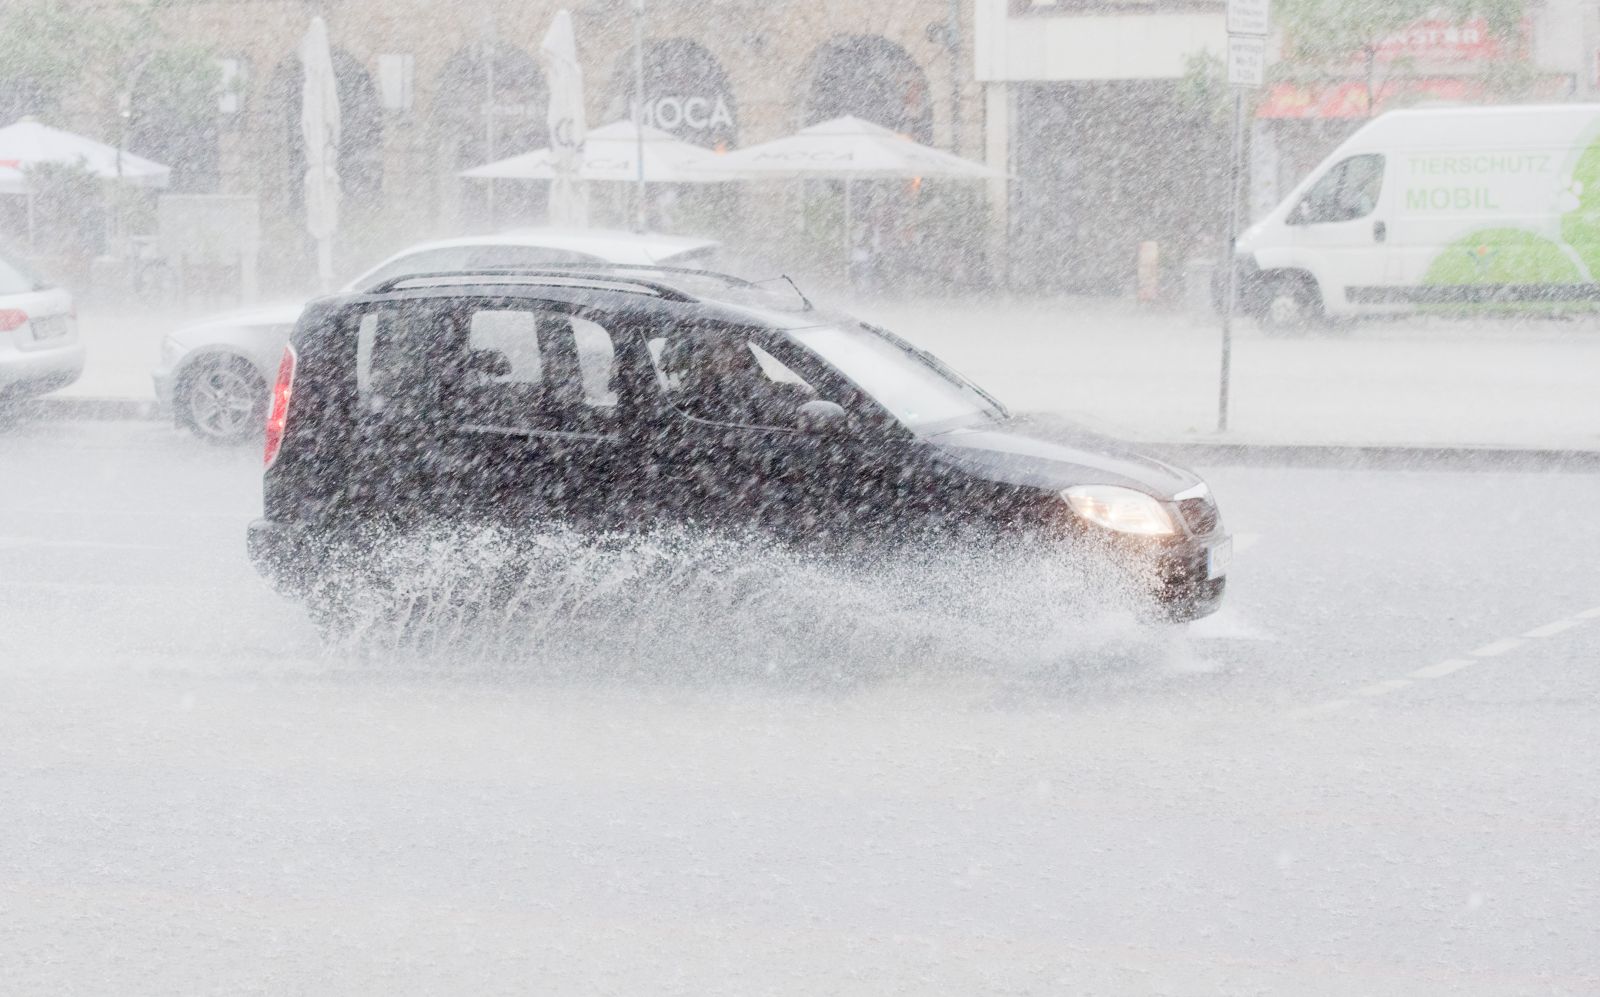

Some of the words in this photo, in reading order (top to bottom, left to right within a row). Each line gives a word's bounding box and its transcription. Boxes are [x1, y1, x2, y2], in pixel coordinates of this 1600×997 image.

[631, 94, 733, 129] MOCA
[752, 150, 856, 163] MOCA
[1407, 154, 1552, 176] TIERSCHUTZ
[1405, 187, 1500, 210] MOBIL
